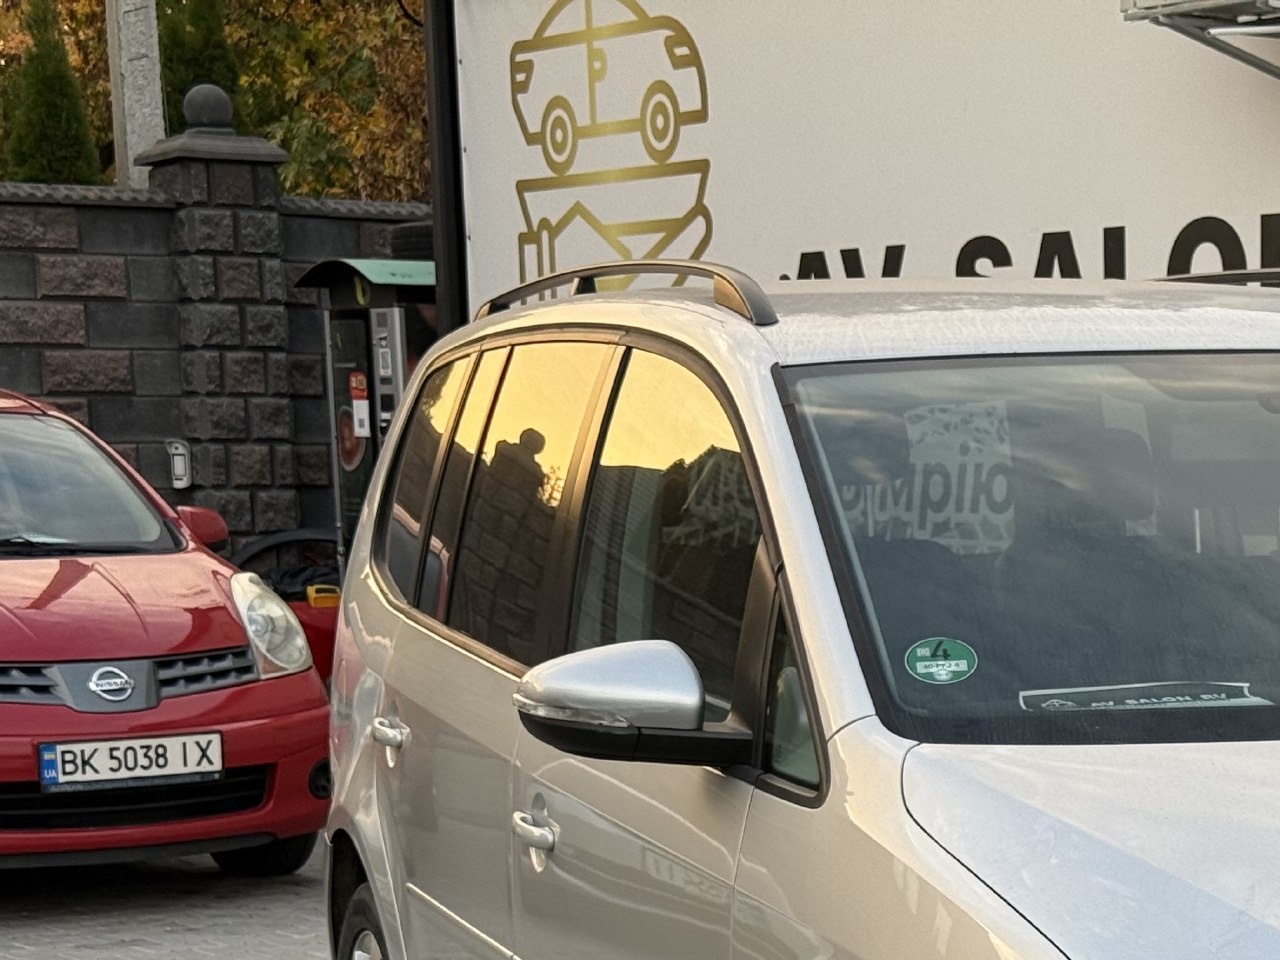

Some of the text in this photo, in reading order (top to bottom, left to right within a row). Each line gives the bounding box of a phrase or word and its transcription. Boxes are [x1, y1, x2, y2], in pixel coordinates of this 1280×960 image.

[930, 640, 951, 660] 4
[60, 748, 101, 777] BK
[108, 743, 169, 773] 5038
[44, 769, 58, 779] UA
